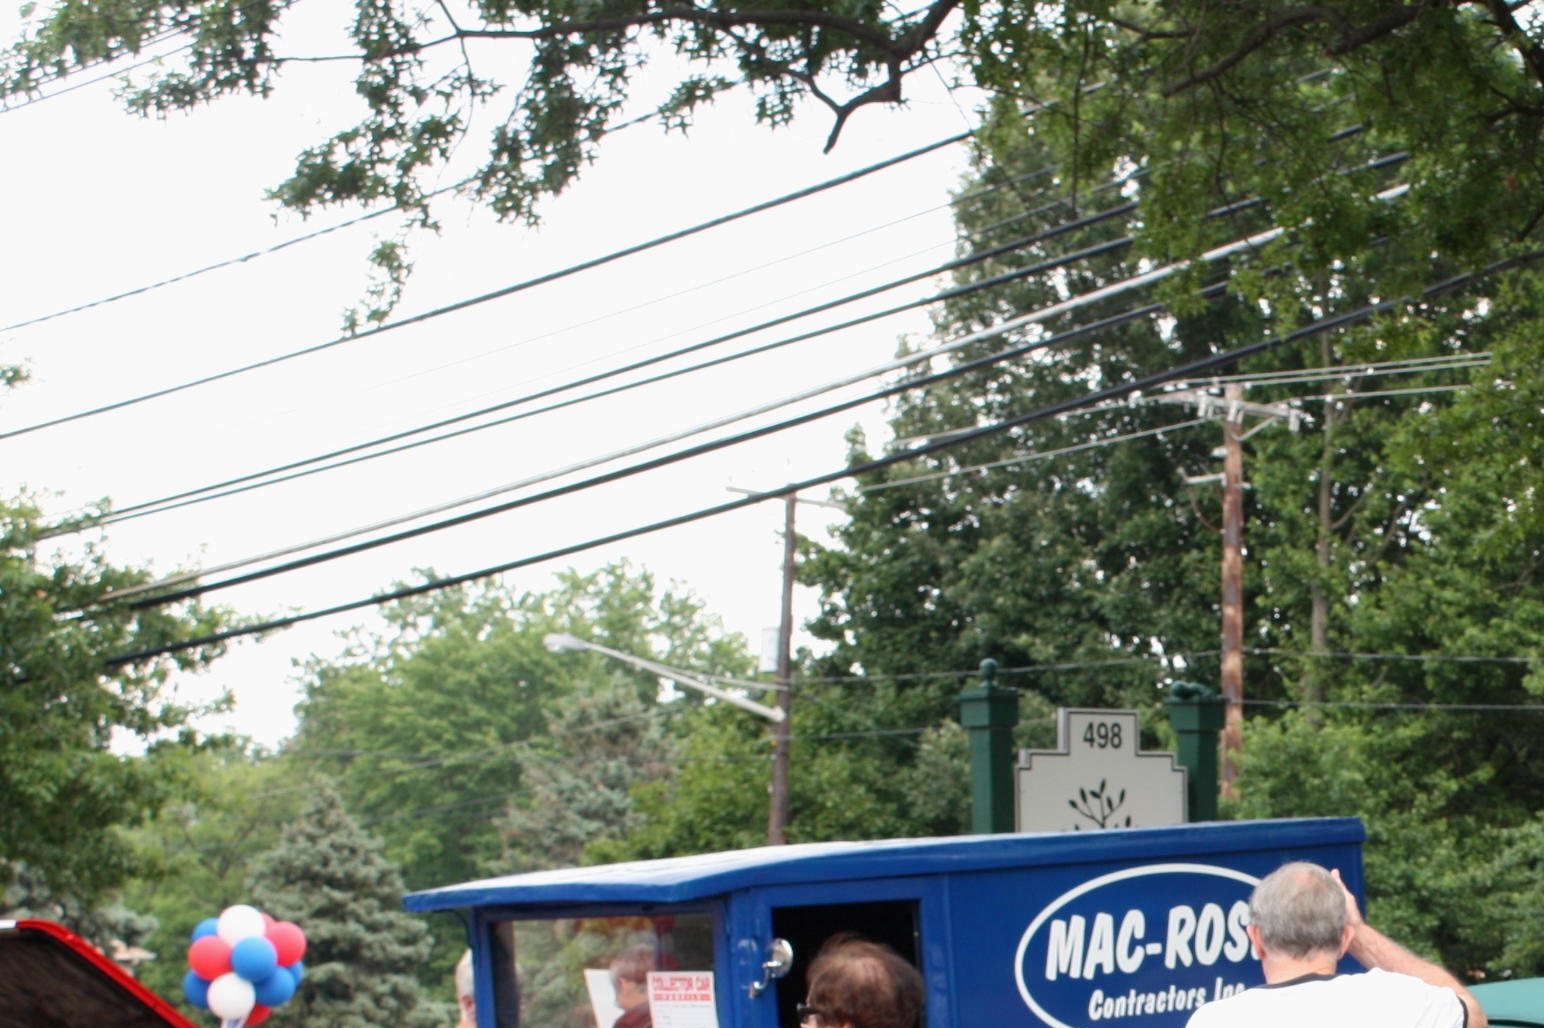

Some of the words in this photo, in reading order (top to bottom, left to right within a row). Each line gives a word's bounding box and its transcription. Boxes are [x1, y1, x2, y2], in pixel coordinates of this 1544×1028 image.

[1083, 722, 1122, 748] 498
[1045, 900, 1261, 981] MAC-ROS
[652, 975, 693, 991] COLLECTOR
[695, 975, 710, 990] CAR
[1088, 985, 1207, 1021] Contractors
